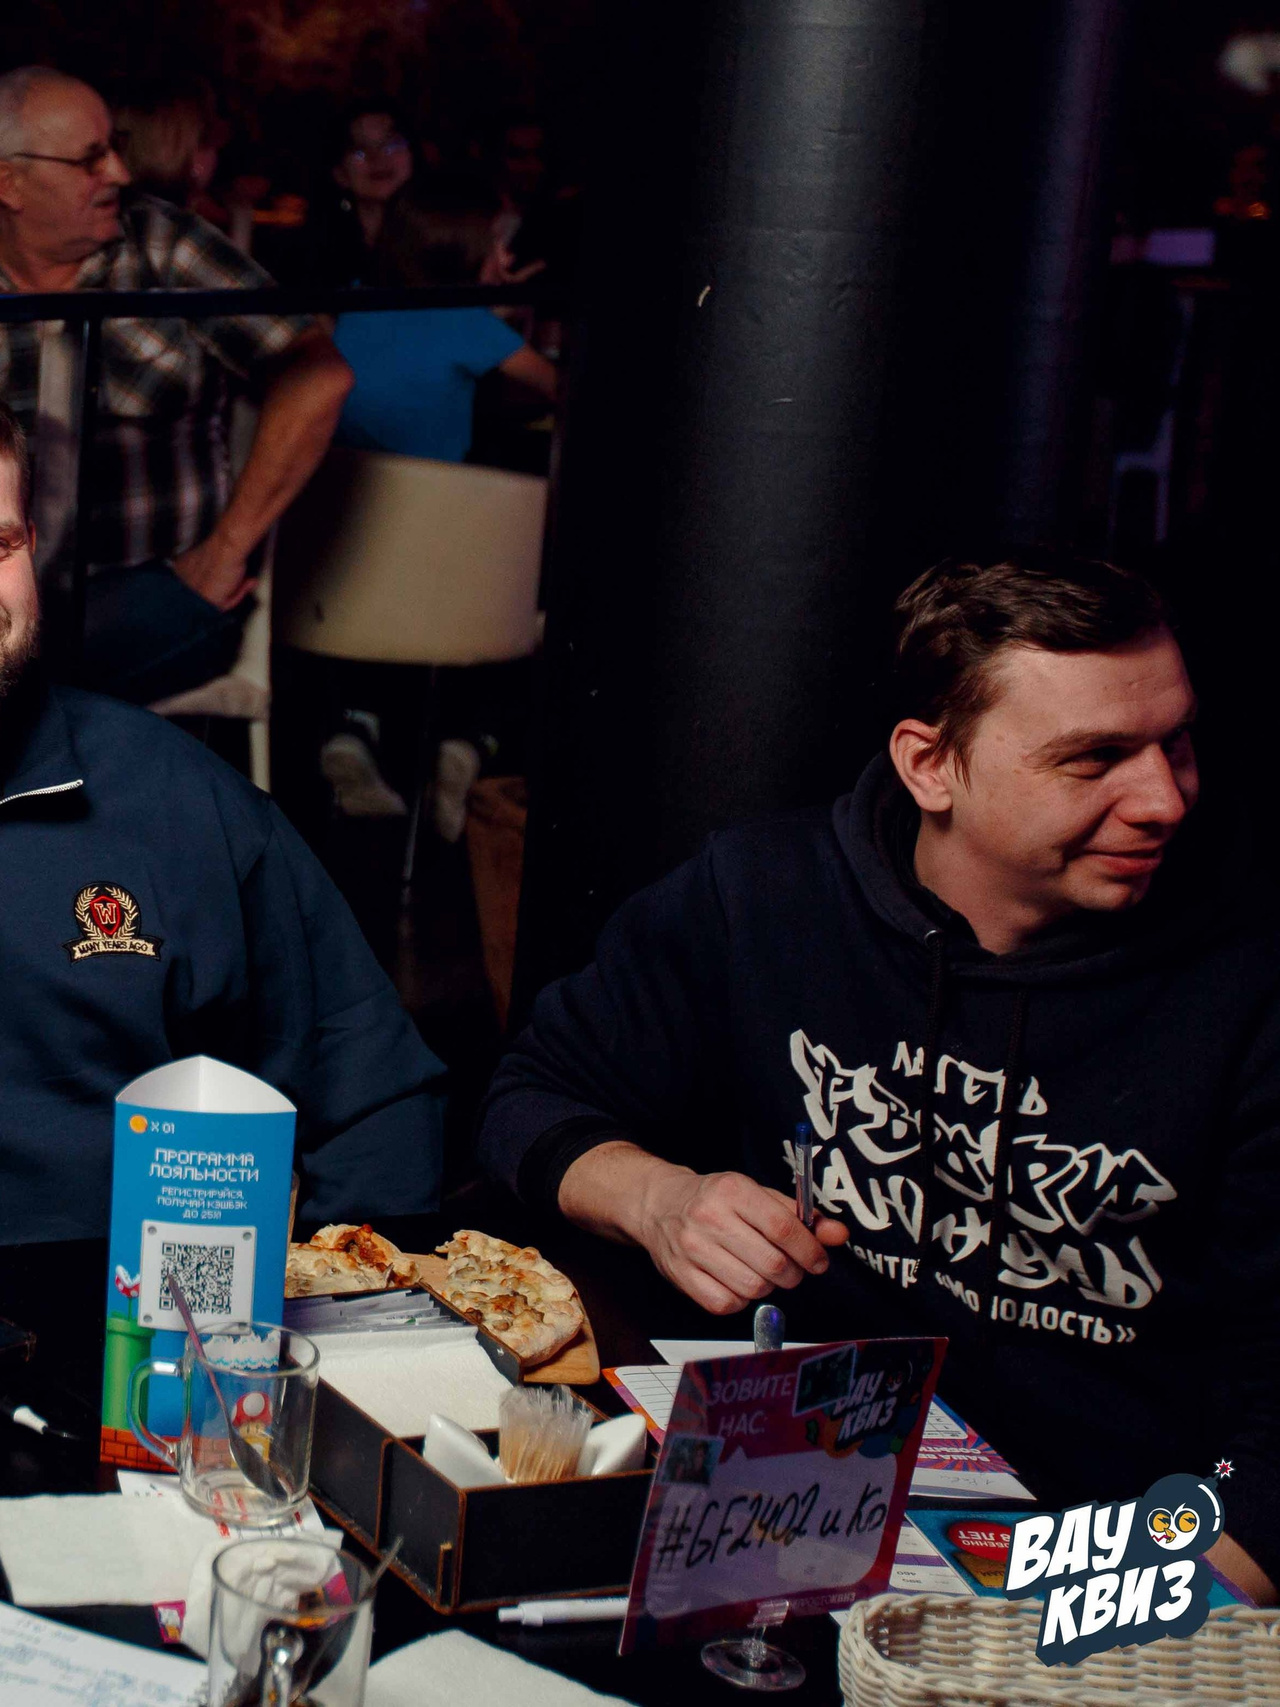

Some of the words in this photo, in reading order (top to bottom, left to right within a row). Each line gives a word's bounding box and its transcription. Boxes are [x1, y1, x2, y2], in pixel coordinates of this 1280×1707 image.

[93, 902, 117, 925] W
[78, 942, 100, 955] MANY
[102, 940, 128, 950] YEARS
[129, 942, 149, 952] AGO
[162, 1122, 176, 1134] 01
[155, 1148, 255, 1167] ПРОГРАММА
[149, 1162, 260, 1182] ЛОЯЛЬНОСТИ
[161, 1186, 245, 1200] РЕГИСТРИРУЙСЯ,
[157, 1196, 205, 1209] ПОЛУЧАЙ
[207, 1200, 248, 1210] КЭШБЭК
[182, 1209, 199, 1219] ДО
[709, 1372, 797, 1406] ЗОВИТЕ
[837, 1399, 897, 1441] КВИЗ
[958, 1530, 995, 1540] ЛЕТ
[962, 1540, 1010, 1549] ОБЕННО
